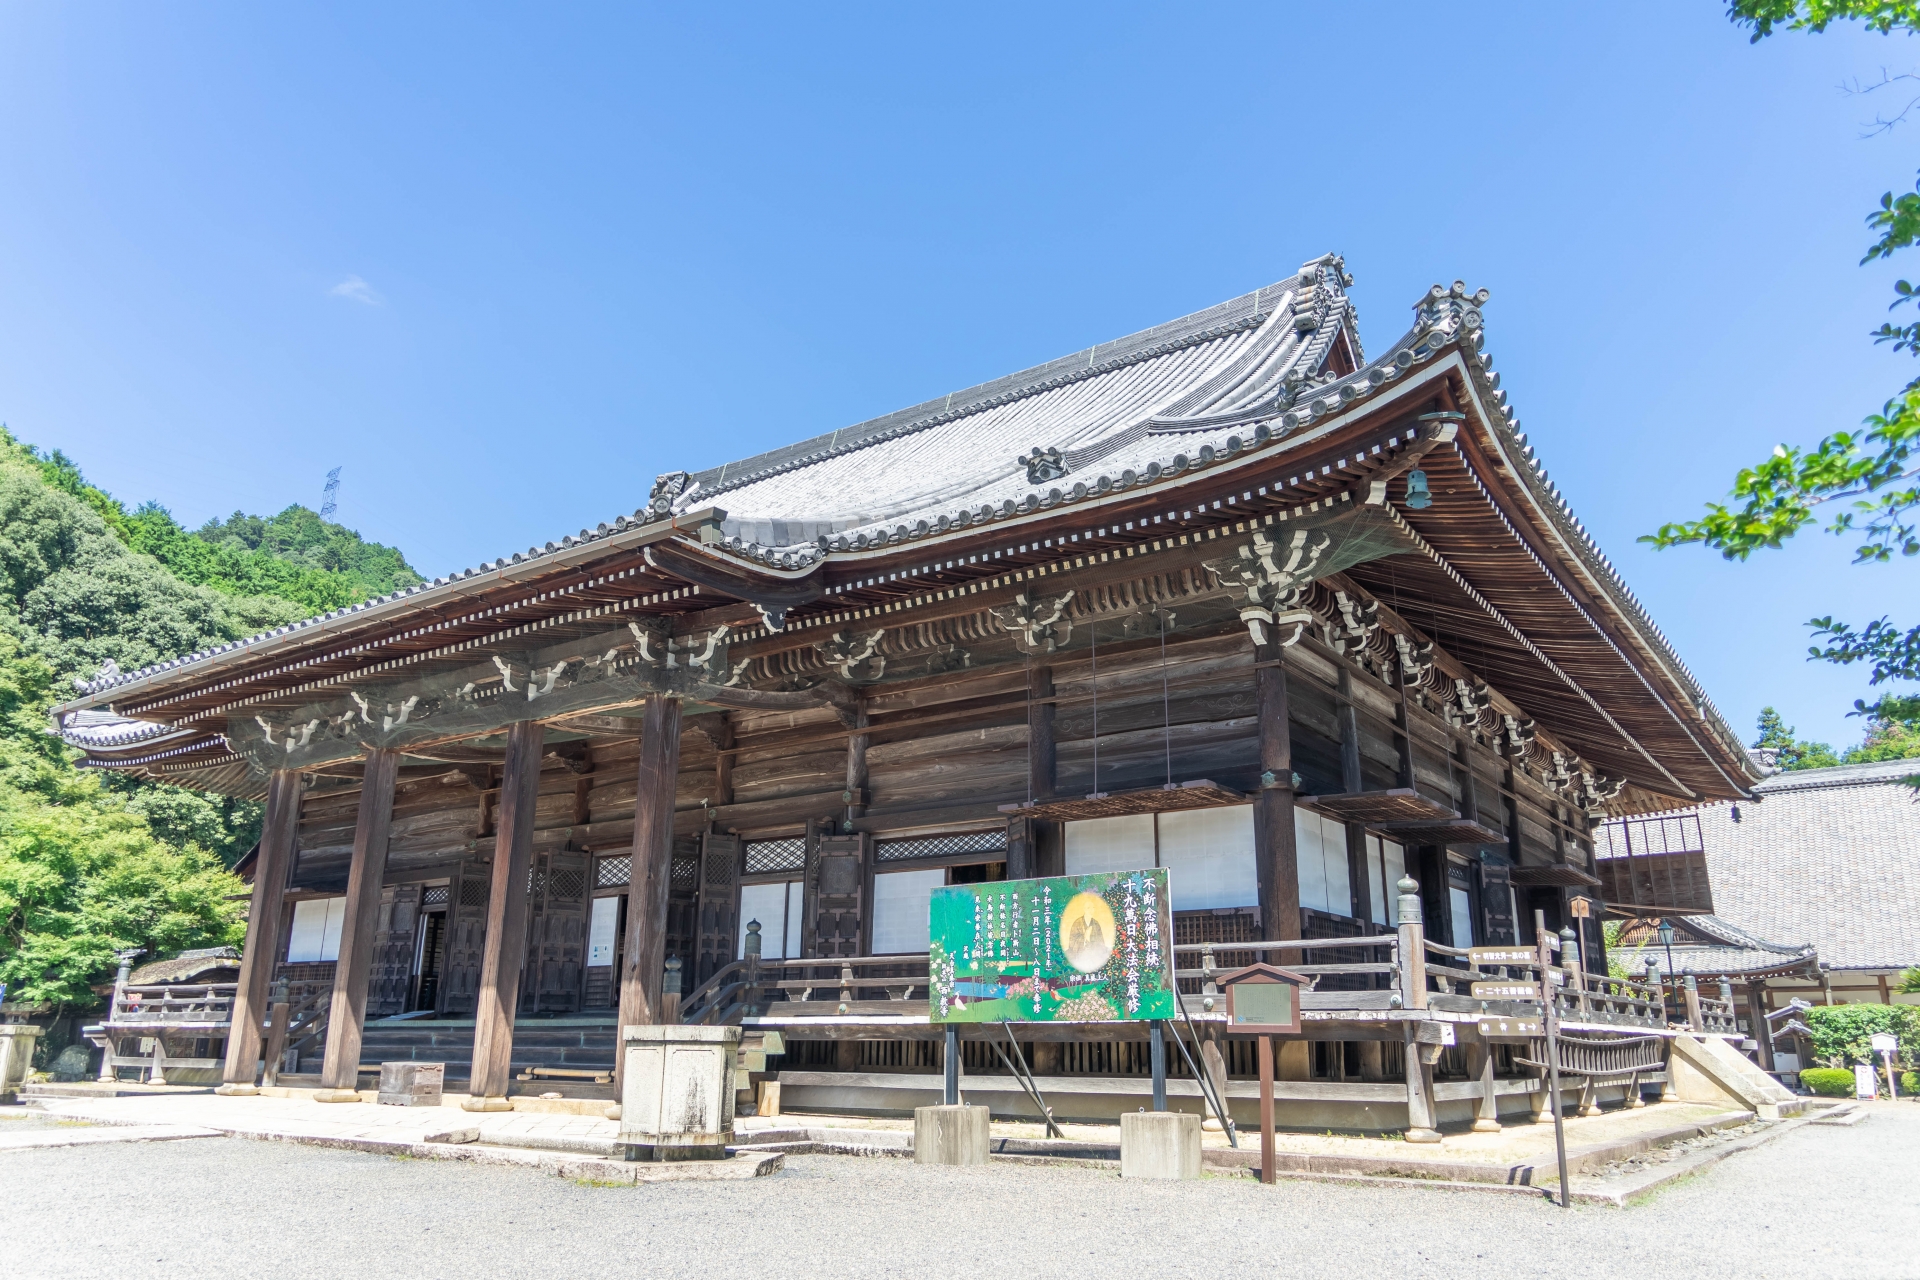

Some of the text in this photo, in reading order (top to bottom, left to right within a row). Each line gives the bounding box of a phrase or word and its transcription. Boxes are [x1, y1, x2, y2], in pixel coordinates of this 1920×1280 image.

[1122, 879, 1141, 1013] 十九萬日大法会厳修
[1143, 878, 1159, 966] 不断念佛相続
[1482, 951, 1531, 960] 明智光秀一族の墓
